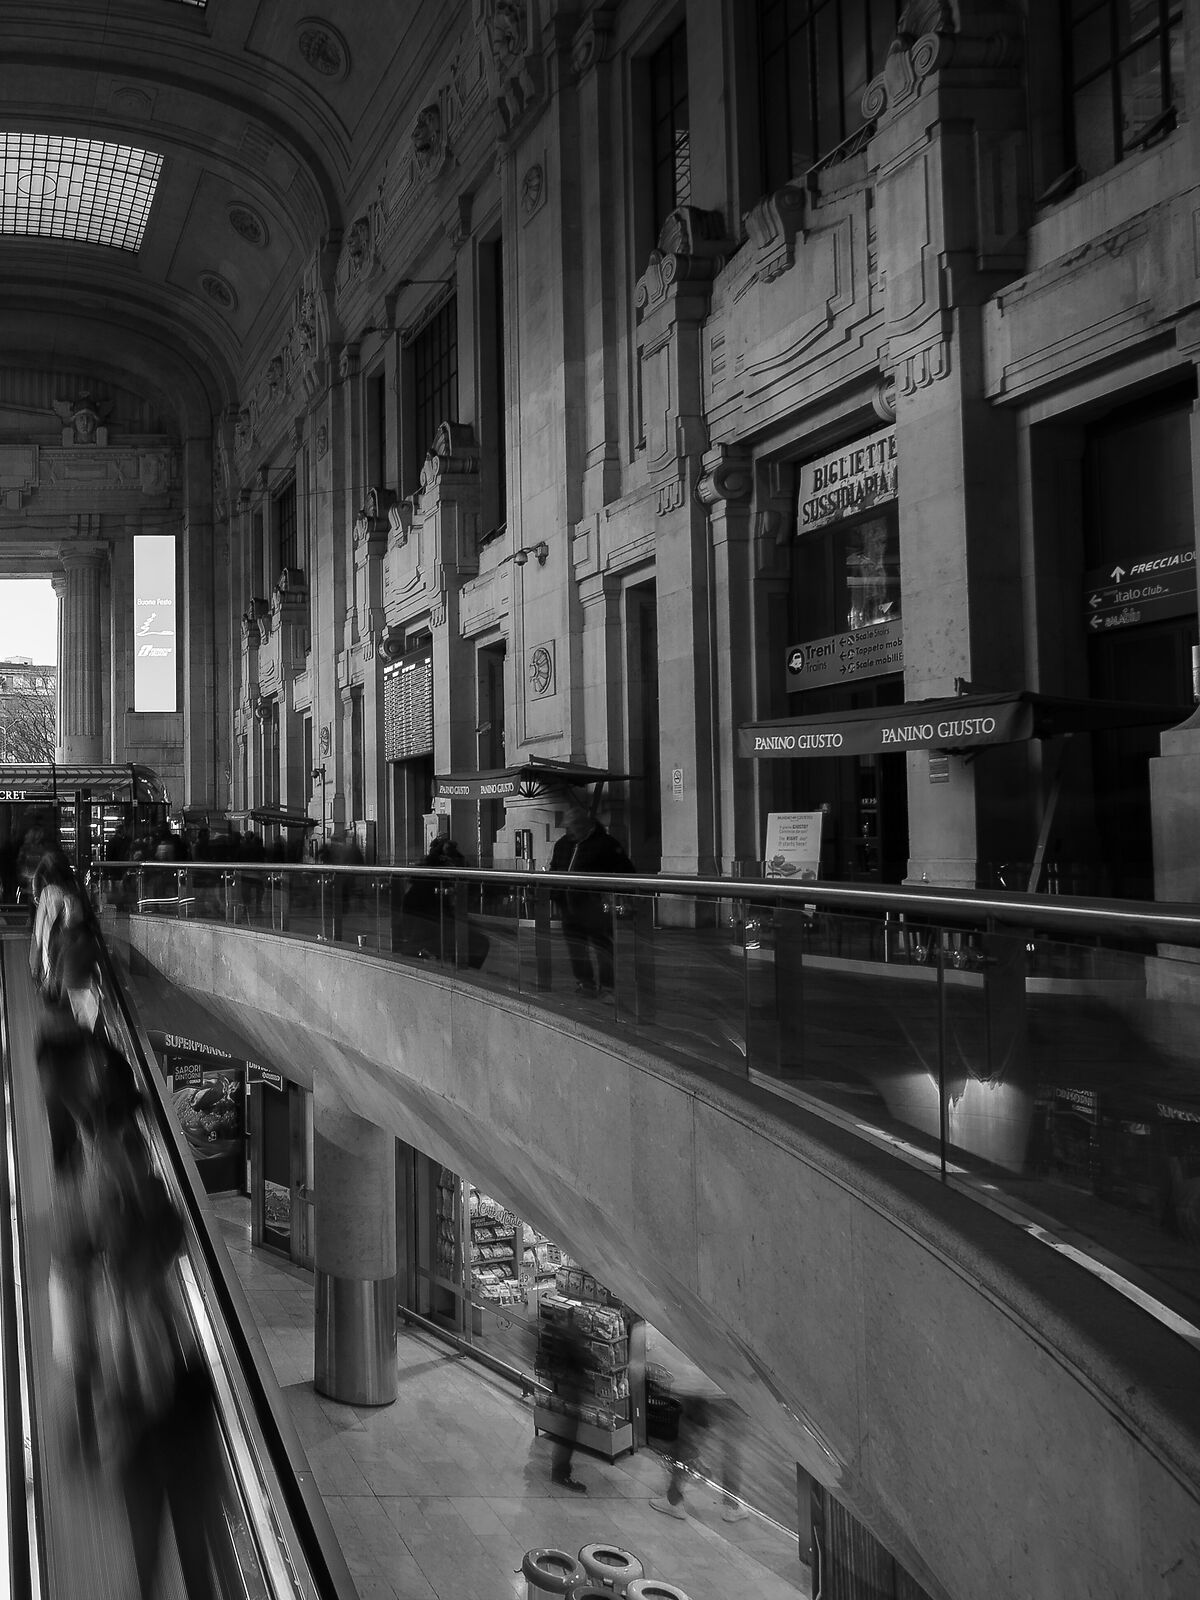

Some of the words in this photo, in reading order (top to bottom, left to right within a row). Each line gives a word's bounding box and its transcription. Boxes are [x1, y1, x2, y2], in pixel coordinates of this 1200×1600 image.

[855, 632, 874, 642] Scale
[805, 639, 836, 659] Treni
[806, 660, 827, 673] Trains
[881, 723, 934, 744] PANINO
[937, 717, 996, 739] GIUSTO
[754, 736, 795, 751] PANINO
[798, 733, 843, 750] GIUSTO
[175, 1064, 201, 1075] SAPORI
